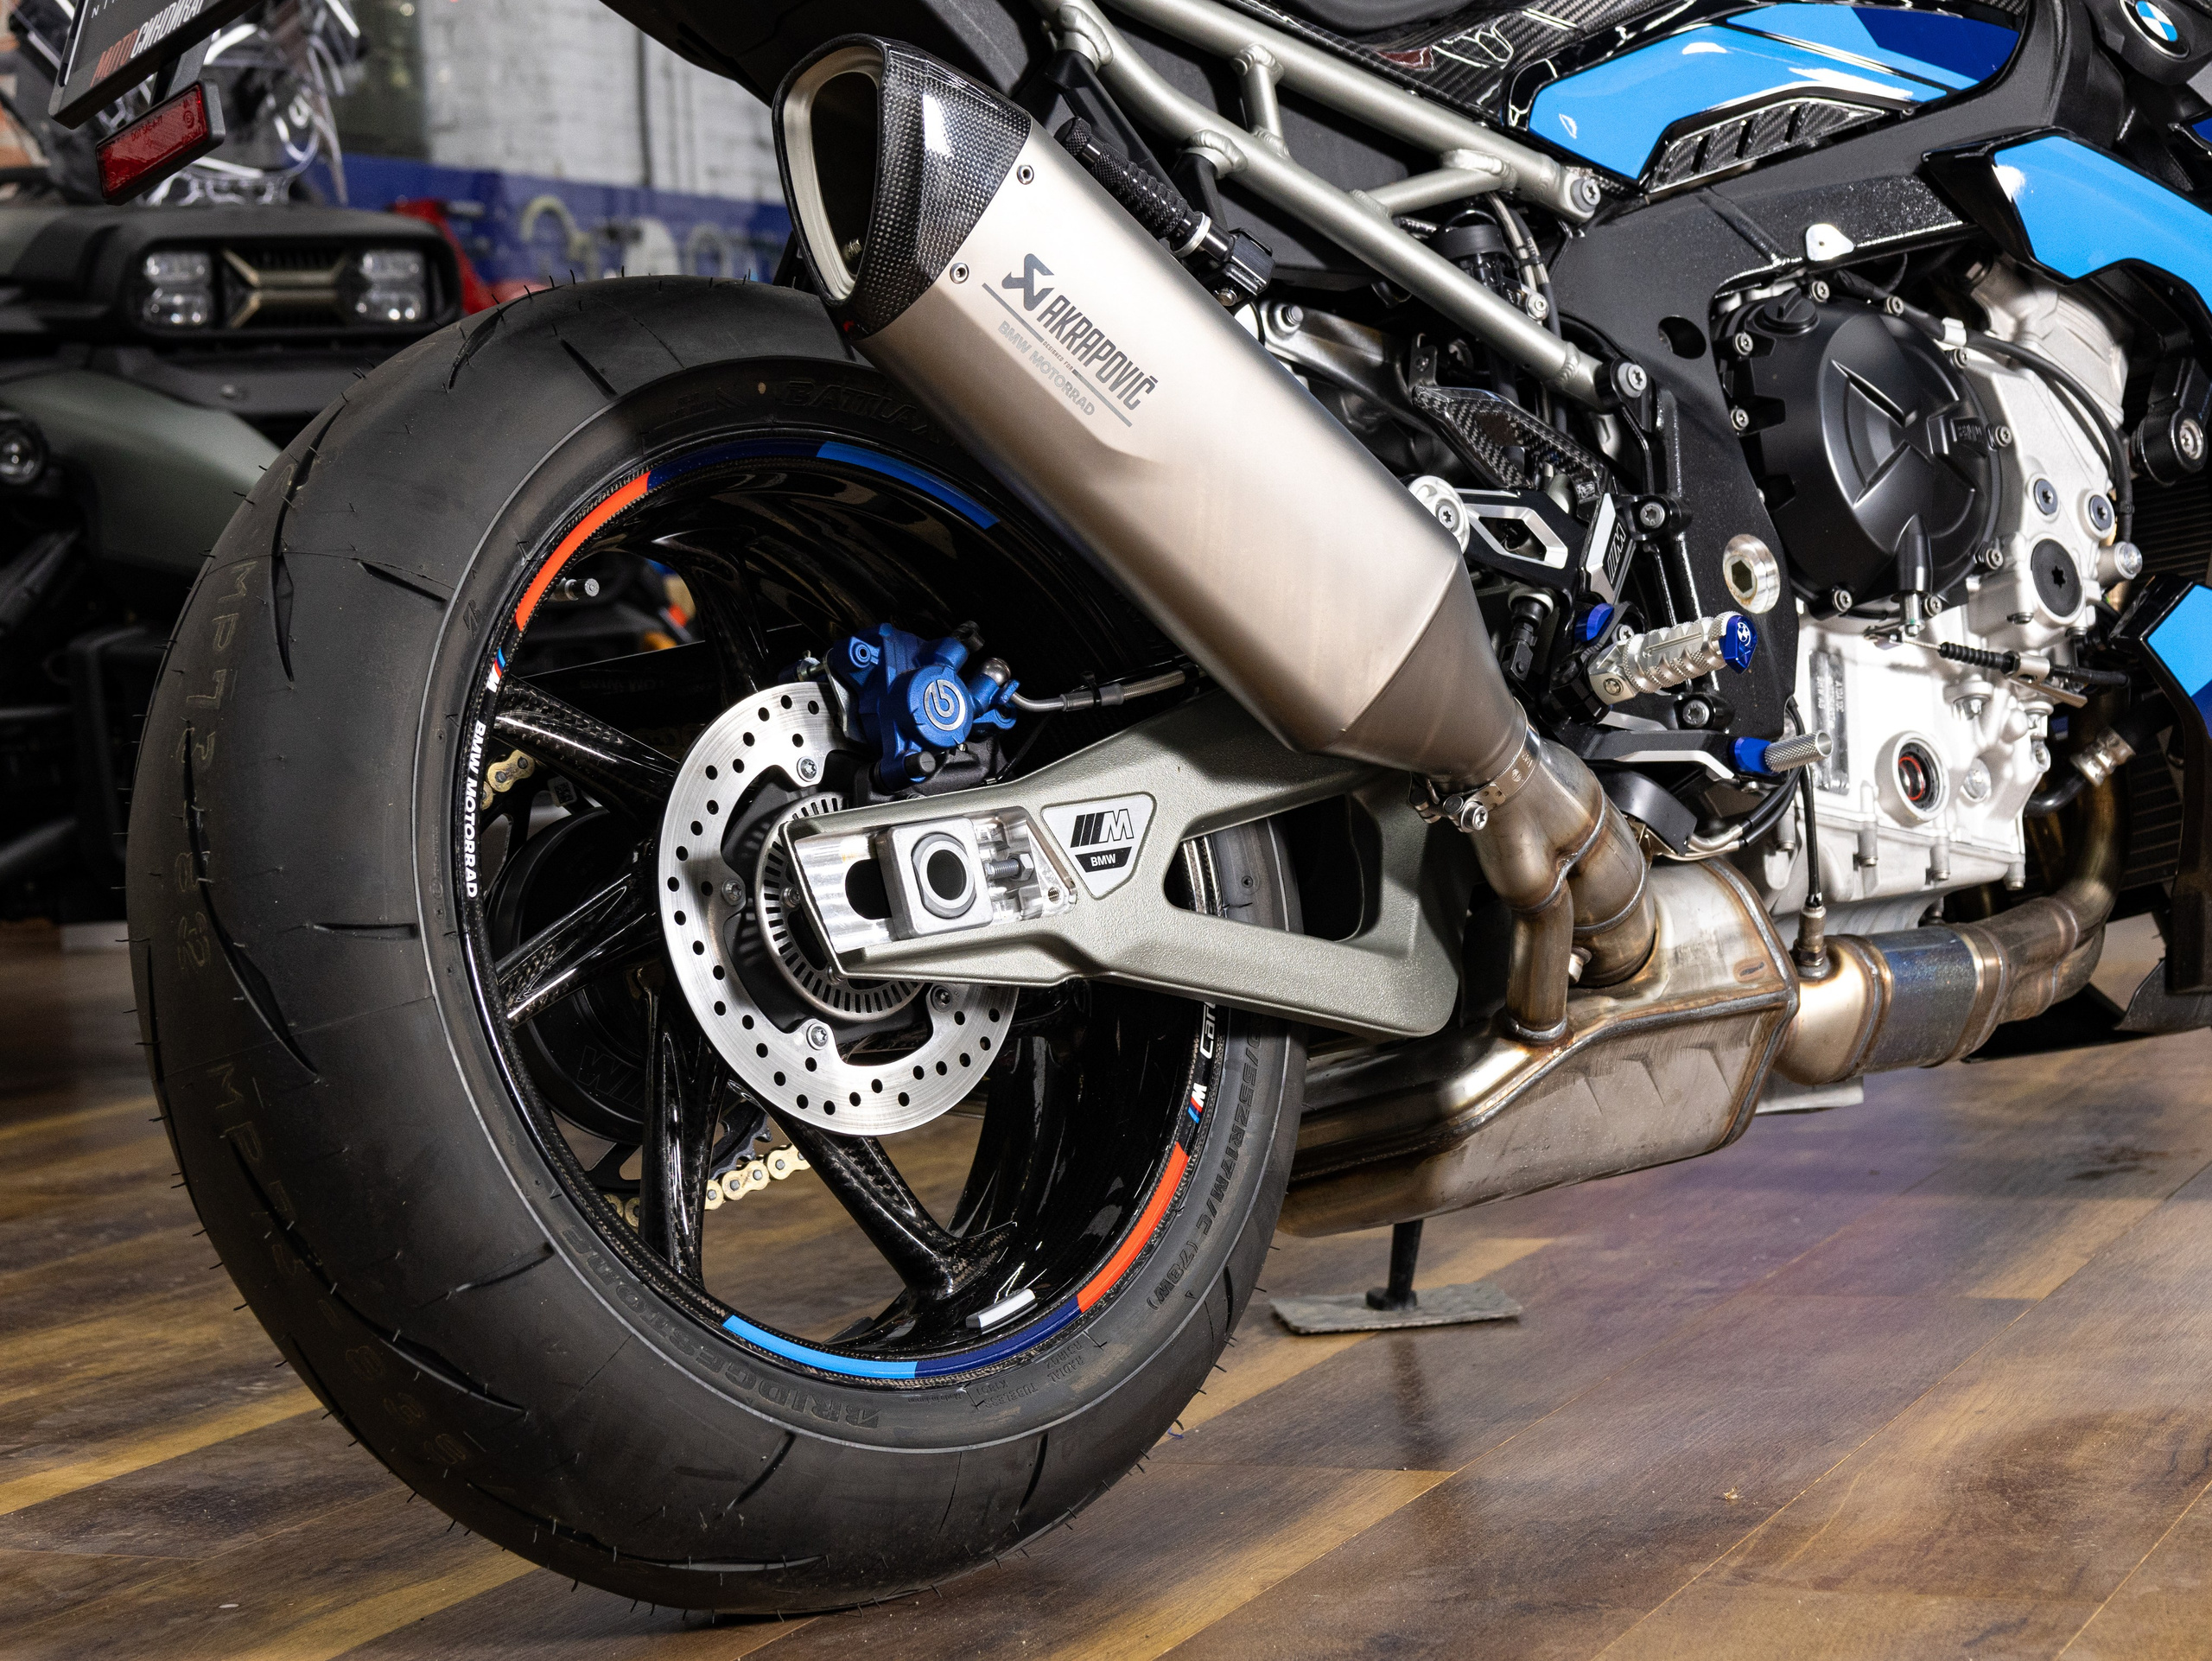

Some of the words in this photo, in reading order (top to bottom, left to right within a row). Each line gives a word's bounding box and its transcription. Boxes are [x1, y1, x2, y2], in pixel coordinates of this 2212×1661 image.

[997, 320, 1032, 355] BMW
[1029, 349, 1096, 417] MOTORRAD
[1037, 294, 1159, 410] AKRAPOVIČ
[1042, 340, 1065, 362] DESIGNED
[1064, 360, 1074, 372] FOR
[467, 719, 486, 774] BMW
[463, 776, 479, 899] MOTORRAD
[1090, 854, 1116, 867] BMW
[1199, 1002, 1216, 1059] Car
[1195, 1013, 1262, 1236] 0/55ZR17M/C
[1146, 1240, 1199, 1311] (78W)
[983, 1384, 1039, 1409] TUBELESS
[1047, 1354, 1086, 1383] RADIAL
